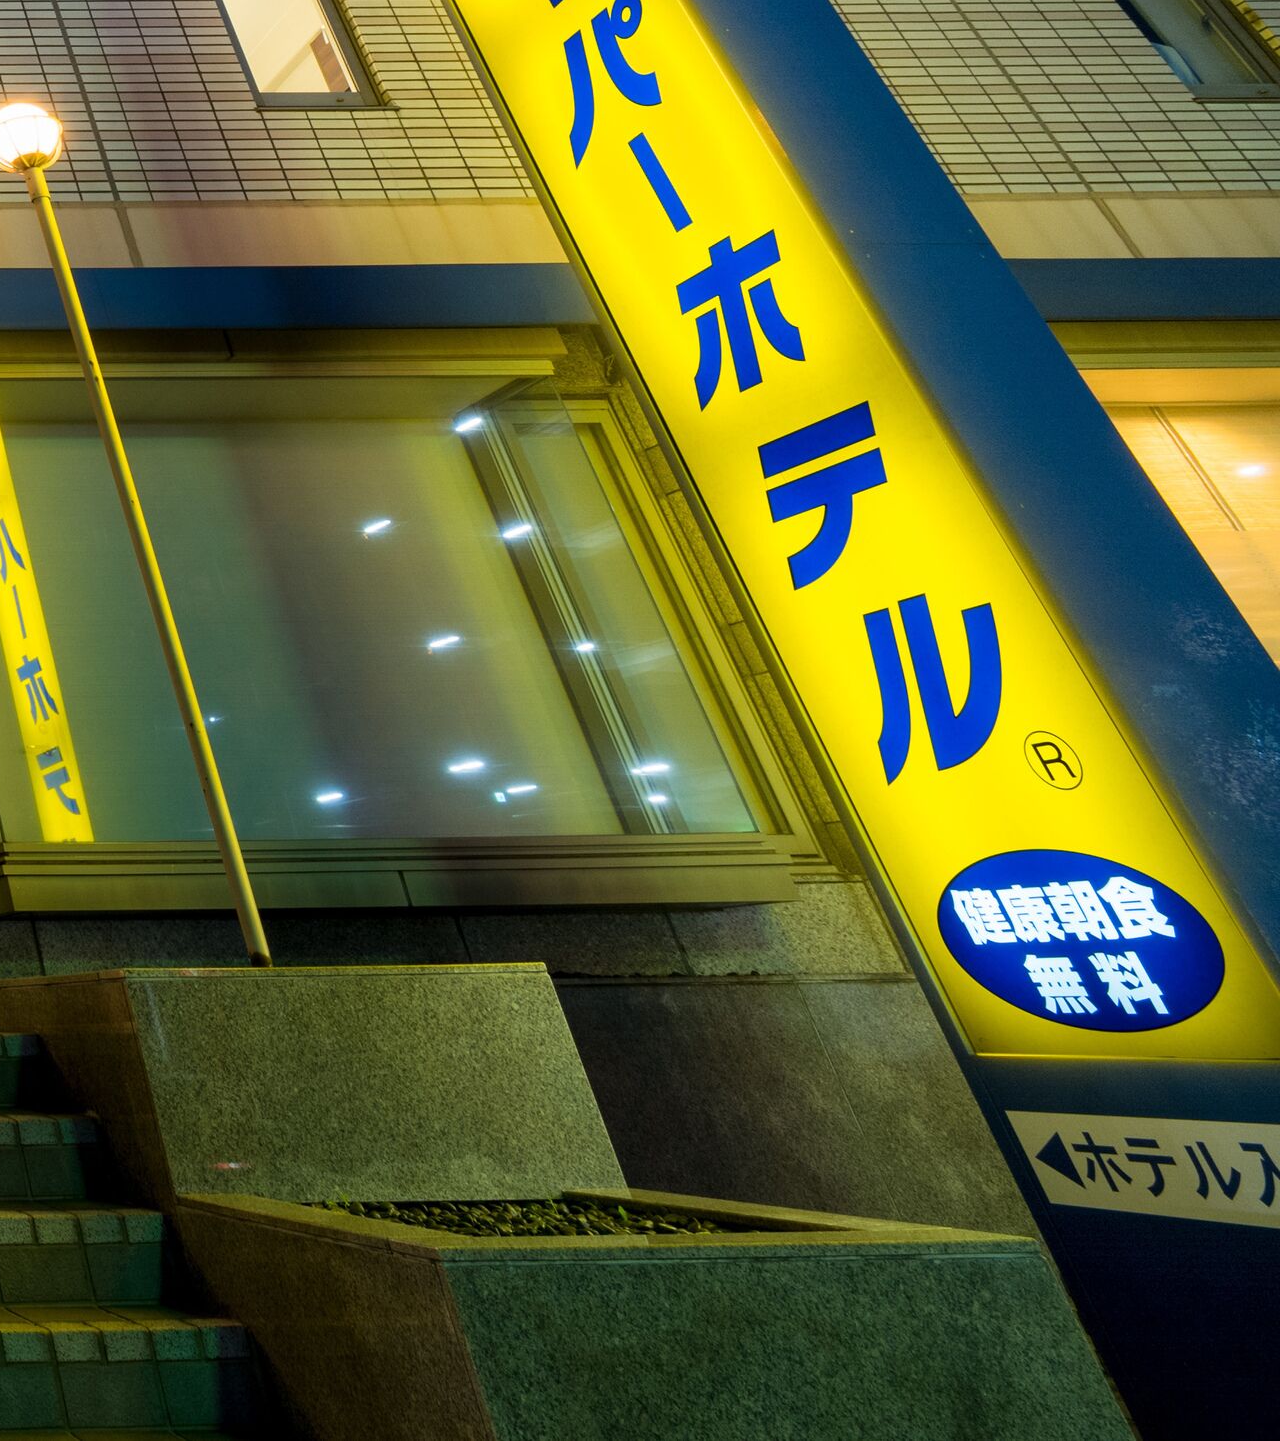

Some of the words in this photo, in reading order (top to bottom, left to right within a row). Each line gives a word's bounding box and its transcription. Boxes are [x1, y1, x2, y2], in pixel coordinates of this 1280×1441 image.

[949, 875, 1176, 946] 健康朝食
[1024, 952, 1170, 1017] 無料
